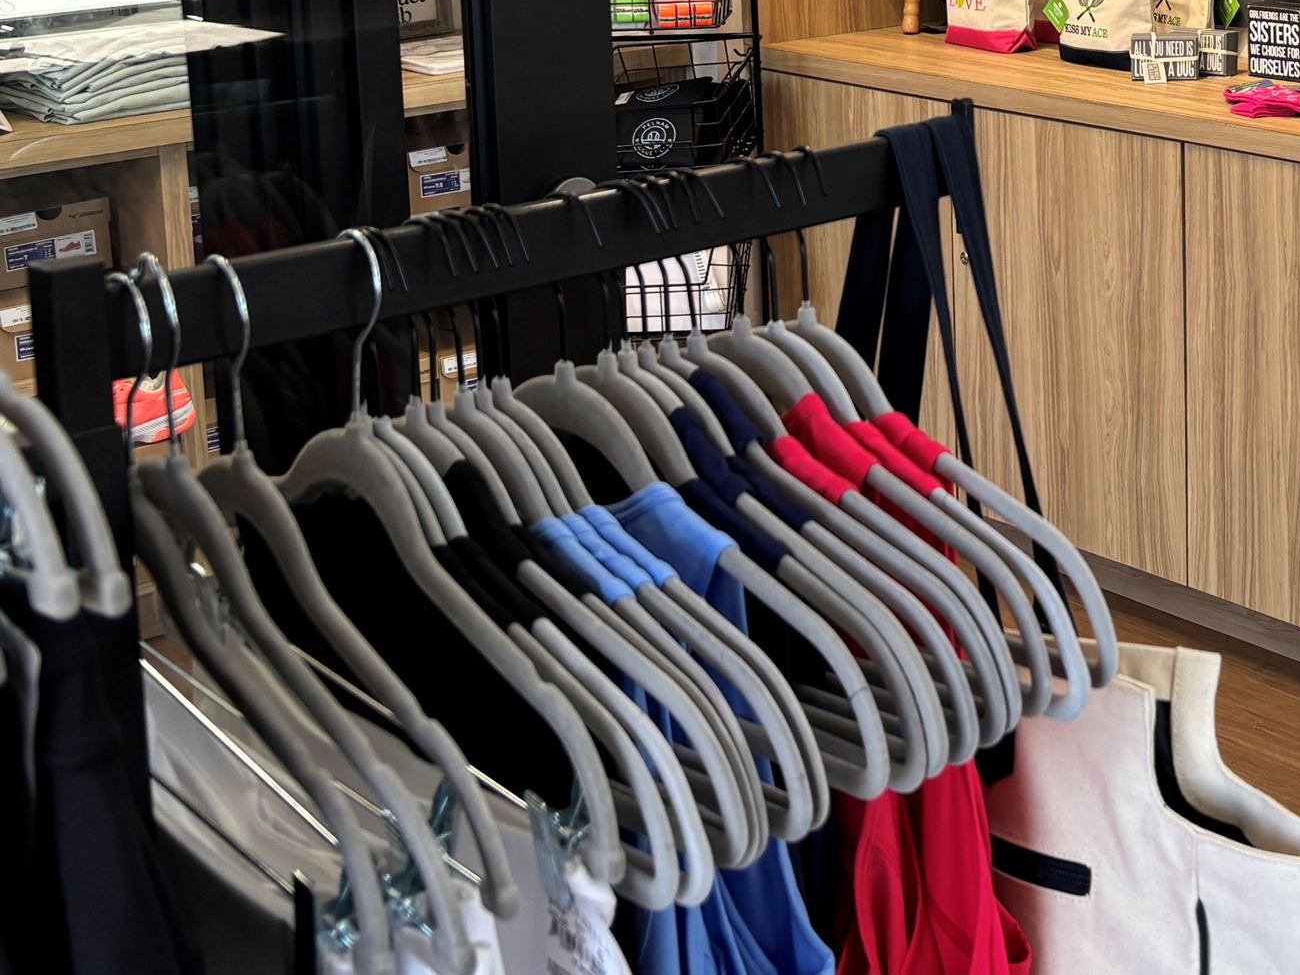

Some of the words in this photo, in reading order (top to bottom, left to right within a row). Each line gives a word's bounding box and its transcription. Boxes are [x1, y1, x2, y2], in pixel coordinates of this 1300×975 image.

[1157, 15, 1168, 24] MY
[1168, 16, 1181, 26] ACE
[1249, 10, 1278, 21] GIRLFRIENDS
[1280, 12, 1289, 21] ARE
[1290, 14, 1299, 22] THE
[1065, 24, 1079, 36] KISS
[1081, 26, 1092, 37] MY
[1092, 28, 1108, 38] ACE
[1249, 21, 1299, 45] SISTERS
[1134, 41, 1147, 55] ALL
[1166, 41, 1184, 56] NEED
[1187, 41, 1193, 56] IS
[1216, 35, 1221, 51] IS
[1250, 44, 1260, 55] WE
[1262, 45, 1286, 58] CHOOSE
[1287, 47, 1299, 59] FOR
[1168, 61, 1174, 76] A
[1177, 61, 1194, 76] DOG
[1207, 54, 1222, 71] DOG
[1250, 58, 1300, 78] OURSELVES
